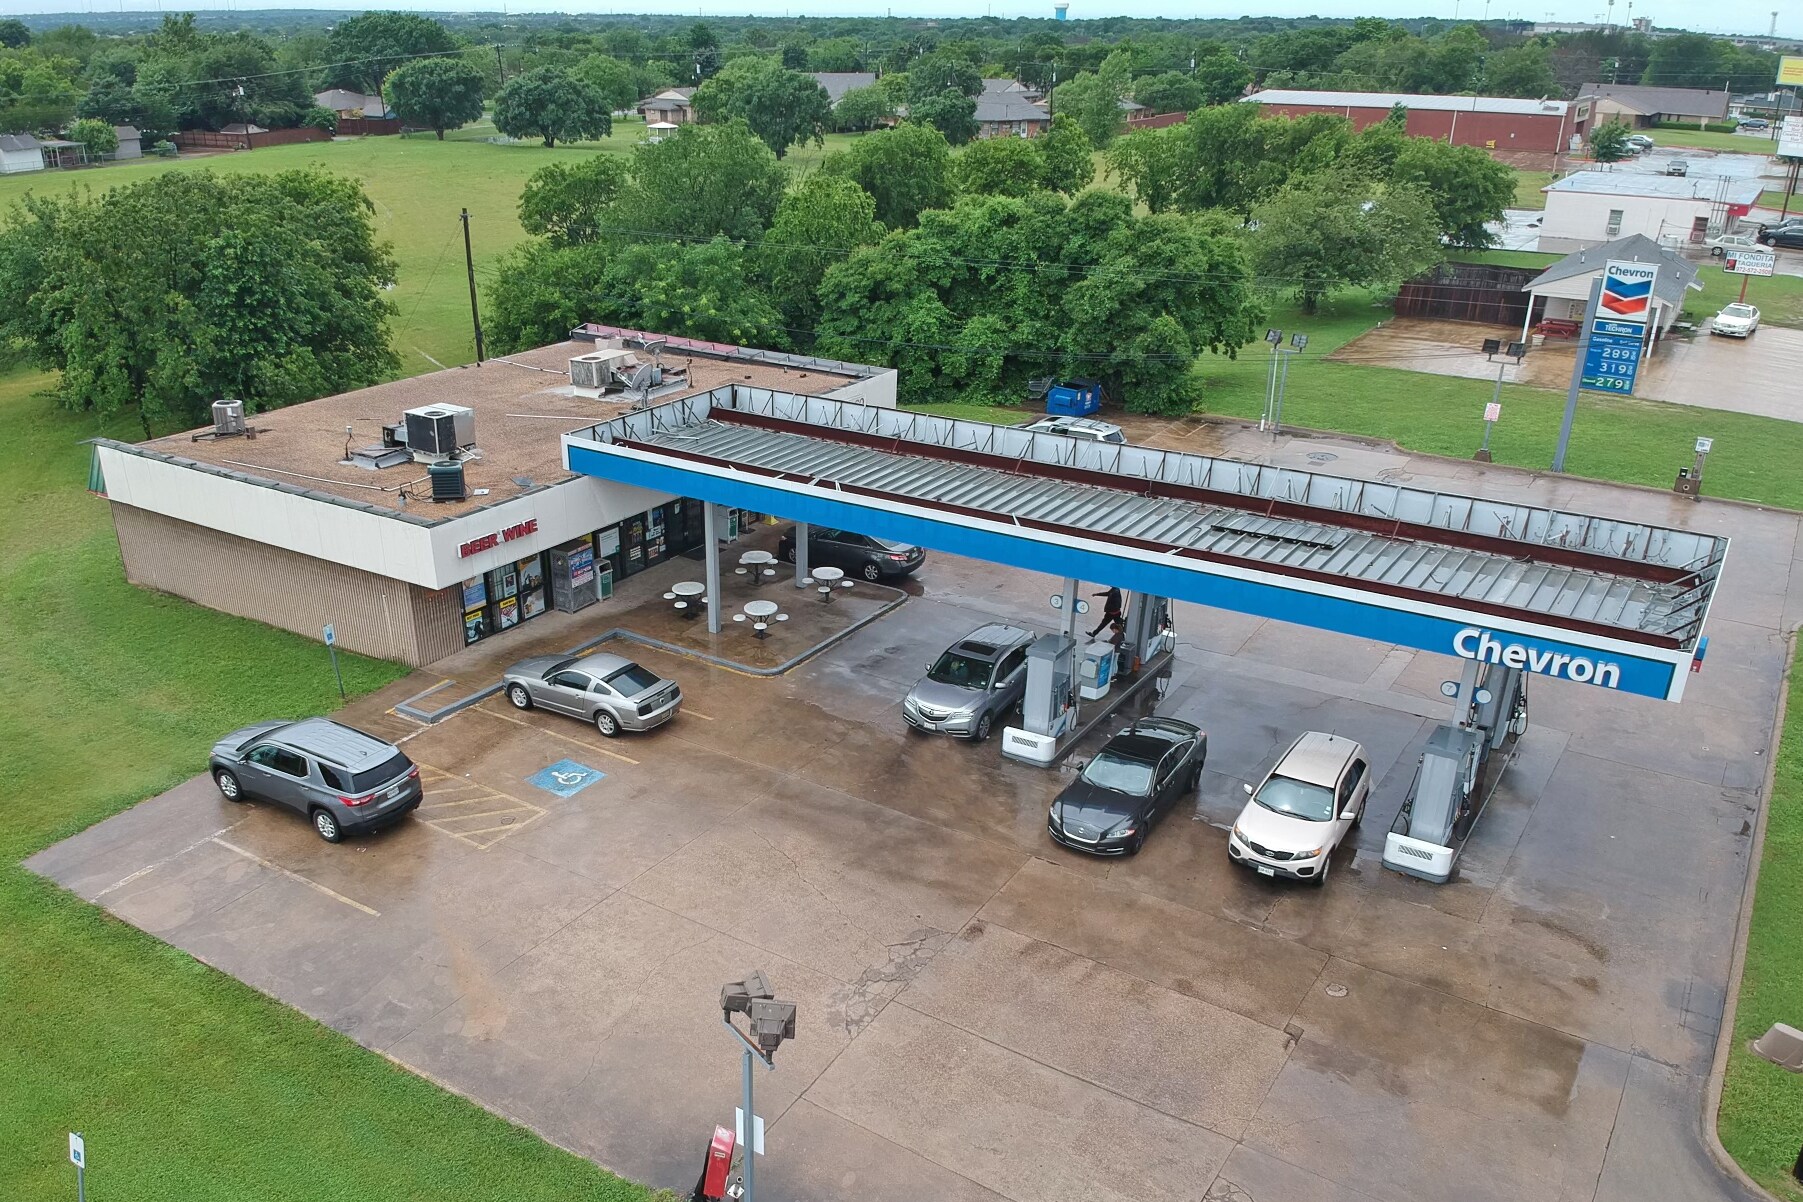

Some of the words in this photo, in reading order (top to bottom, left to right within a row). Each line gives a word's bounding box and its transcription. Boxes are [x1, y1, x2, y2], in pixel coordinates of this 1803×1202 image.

[1738, 253, 1774, 262] FONDITA
[1737, 260, 1773, 268] TAQUERIA
[1608, 265, 1654, 279] Chevron
[1602, 347, 1630, 359] 289
[1599, 362, 1627, 374] 319
[1595, 377, 1624, 389] 279
[460, 533, 500, 559] BEER
[501, 518, 539, 543] WINE
[1453, 627, 1621, 689] Chevron
